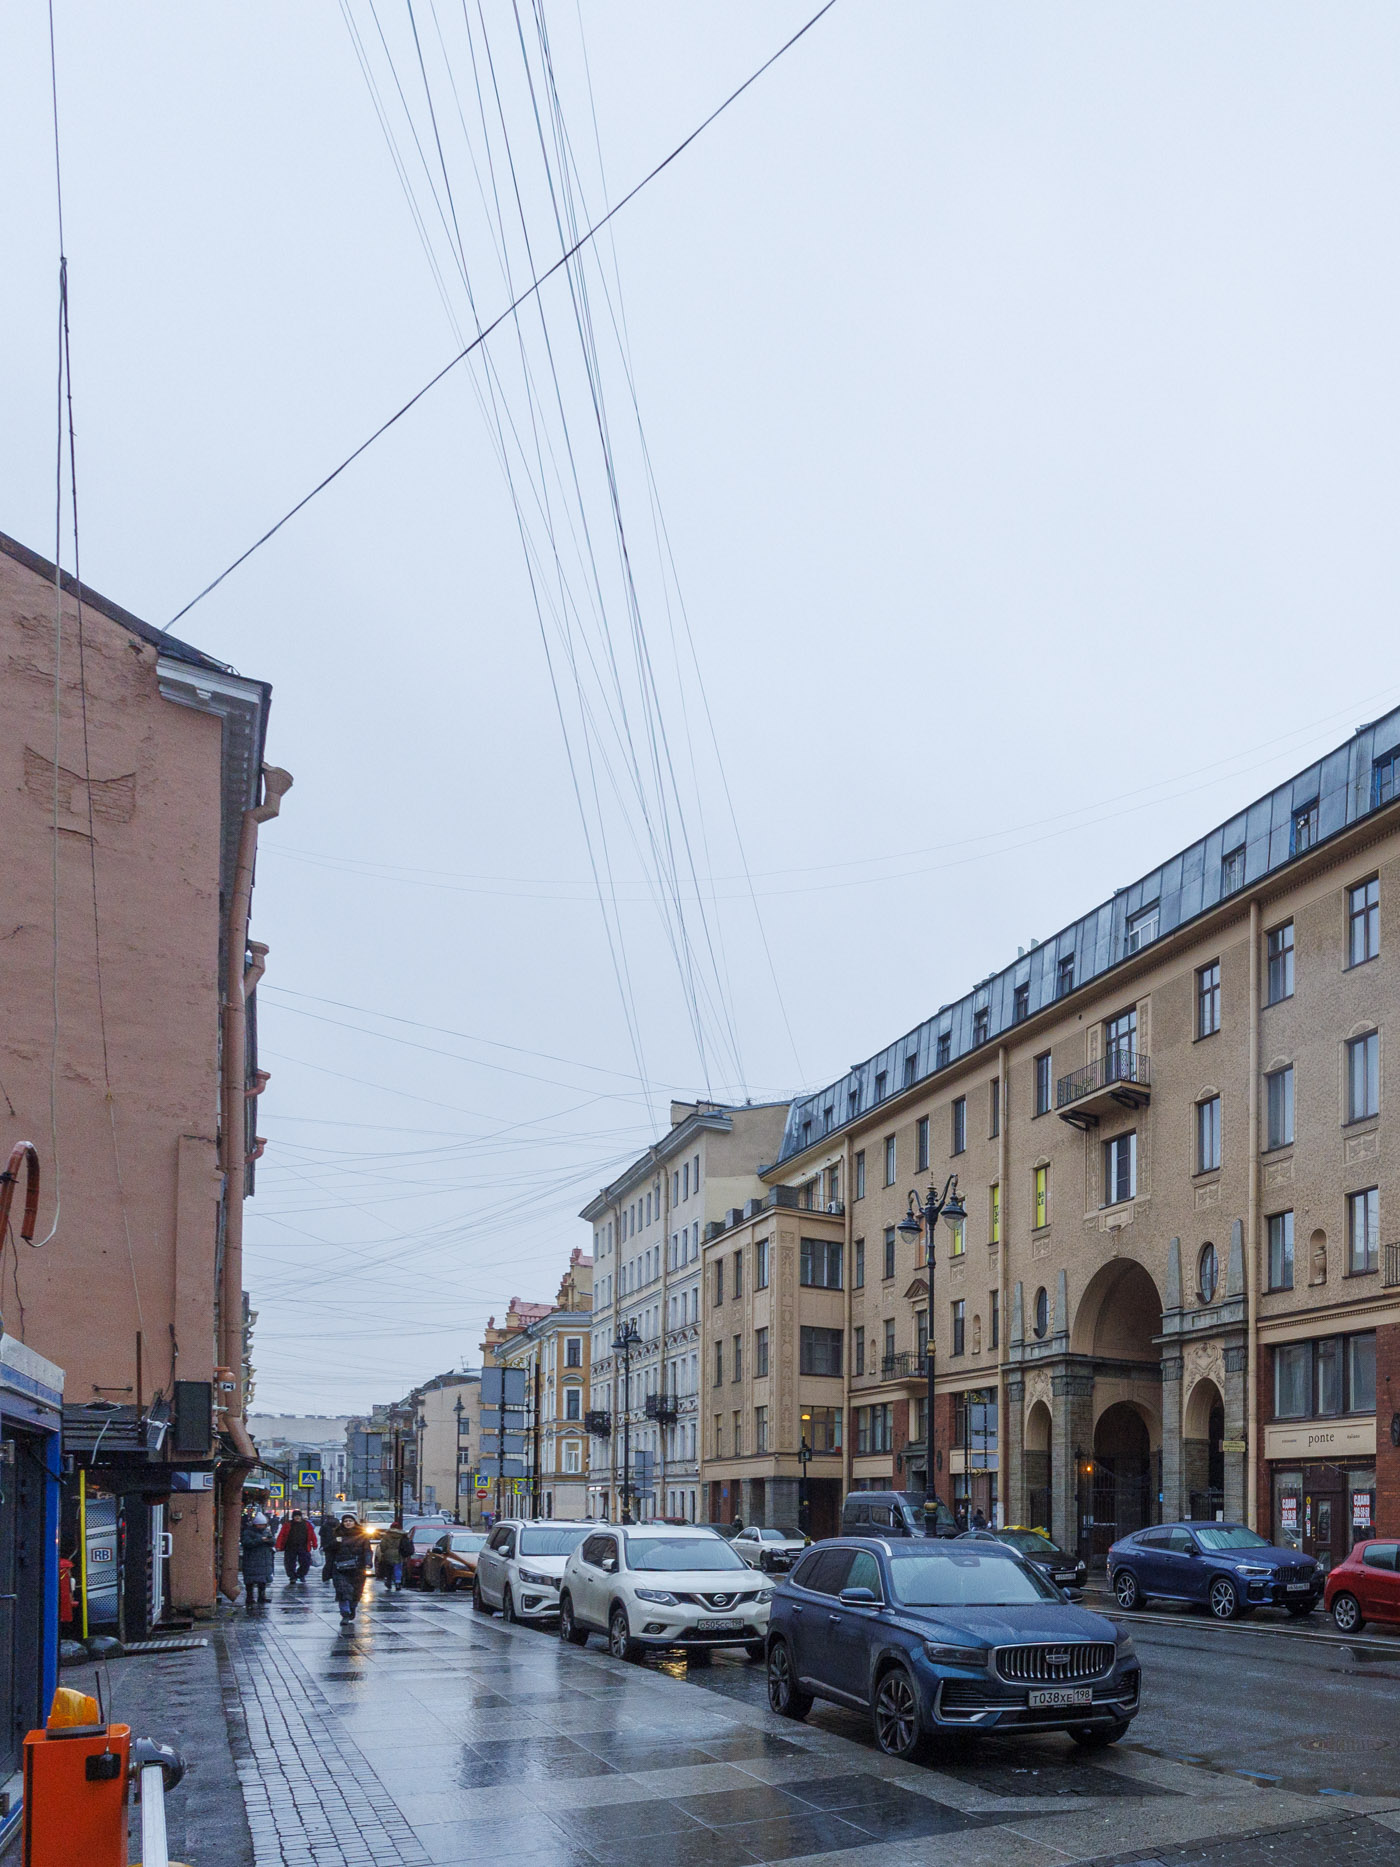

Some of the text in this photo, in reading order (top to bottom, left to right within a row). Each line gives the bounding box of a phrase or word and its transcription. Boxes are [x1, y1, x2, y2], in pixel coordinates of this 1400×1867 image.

[1308, 1433, 1335, 1447] ponte
[94, 1550, 110, 1561] RB
[1075, 1690, 1090, 1699] 198
